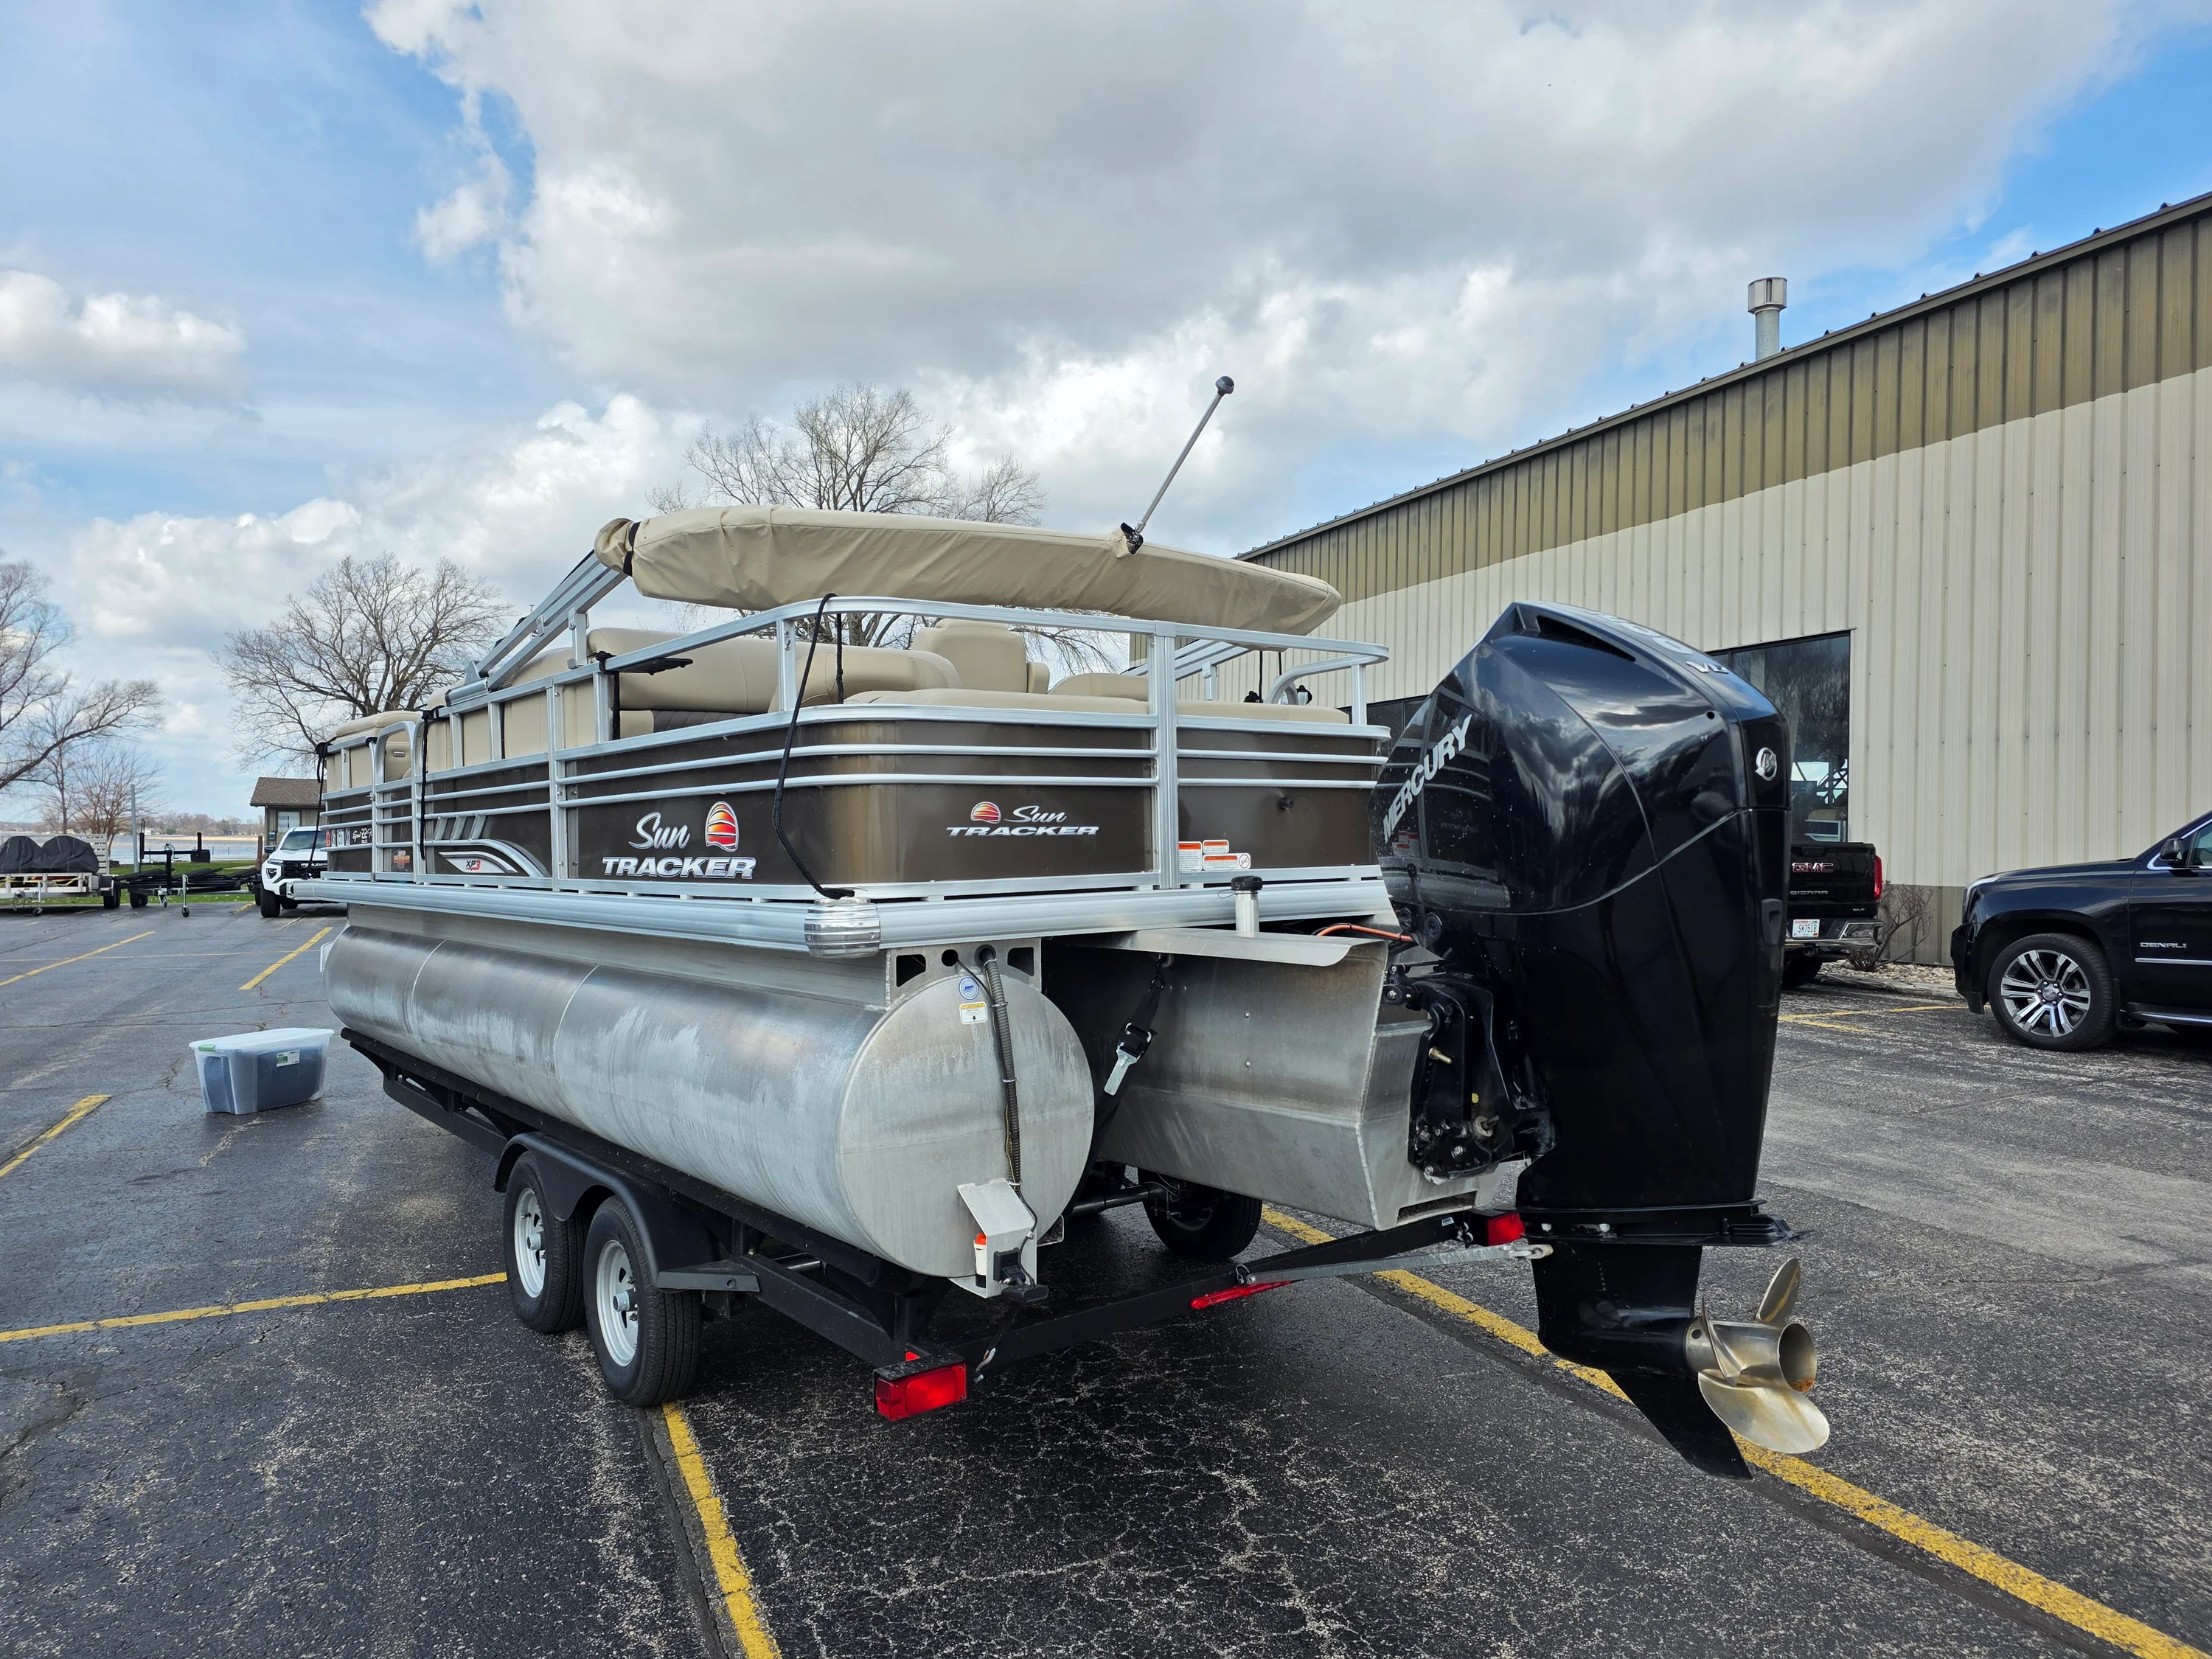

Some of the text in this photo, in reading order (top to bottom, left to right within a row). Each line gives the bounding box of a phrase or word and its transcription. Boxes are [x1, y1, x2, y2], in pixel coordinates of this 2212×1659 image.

[1382, 714, 1472, 845] MERCURY
[1004, 805, 1067, 823] Sun
[628, 811, 691, 849] Sun
[946, 826, 1099, 837] TRACKER
[465, 860, 481, 871] XP3
[602, 856, 757, 880] TRACKER
[1792, 862, 1834, 873] GMC
